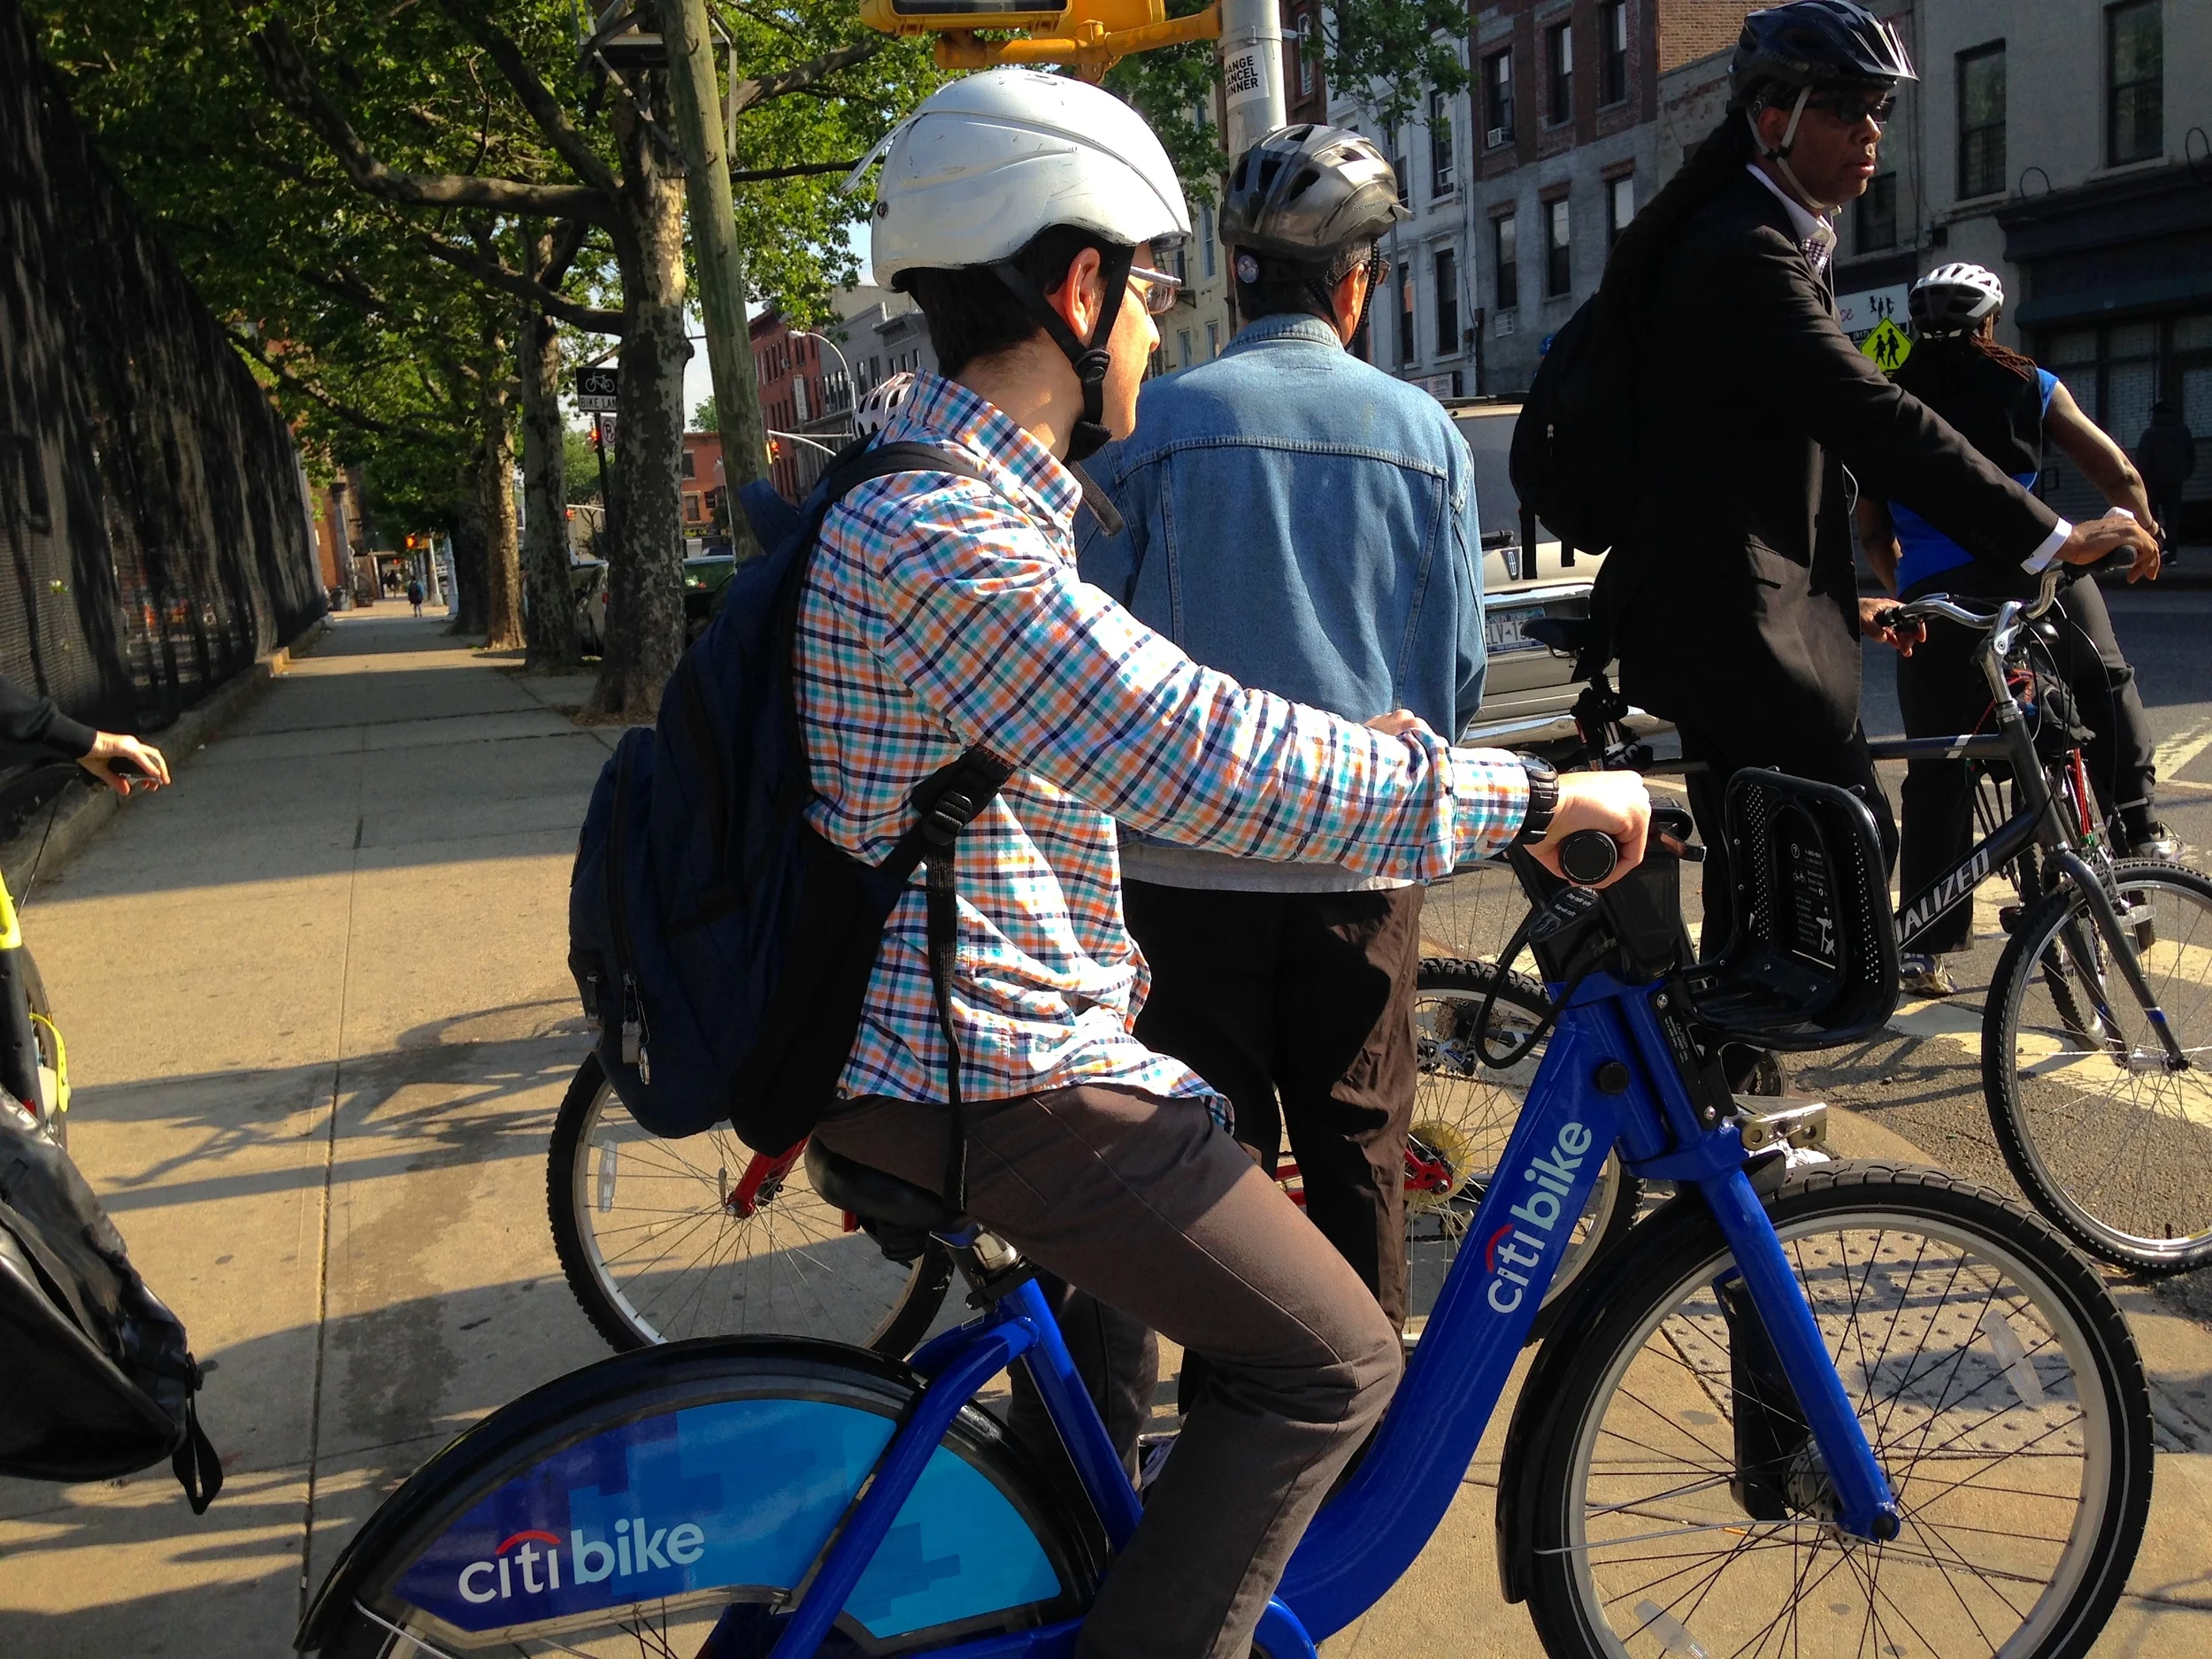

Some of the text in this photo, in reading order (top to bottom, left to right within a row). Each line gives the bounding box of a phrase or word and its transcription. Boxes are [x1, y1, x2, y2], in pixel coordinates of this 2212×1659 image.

[1225, 67, 1258, 86] ANCEL
[580, 397, 617, 409] BIKE LAN
[1894, 848, 1990, 944] IALIZED
[1486, 1122, 1593, 1314] citi bike
[458, 1517, 705, 1604] citi bike
